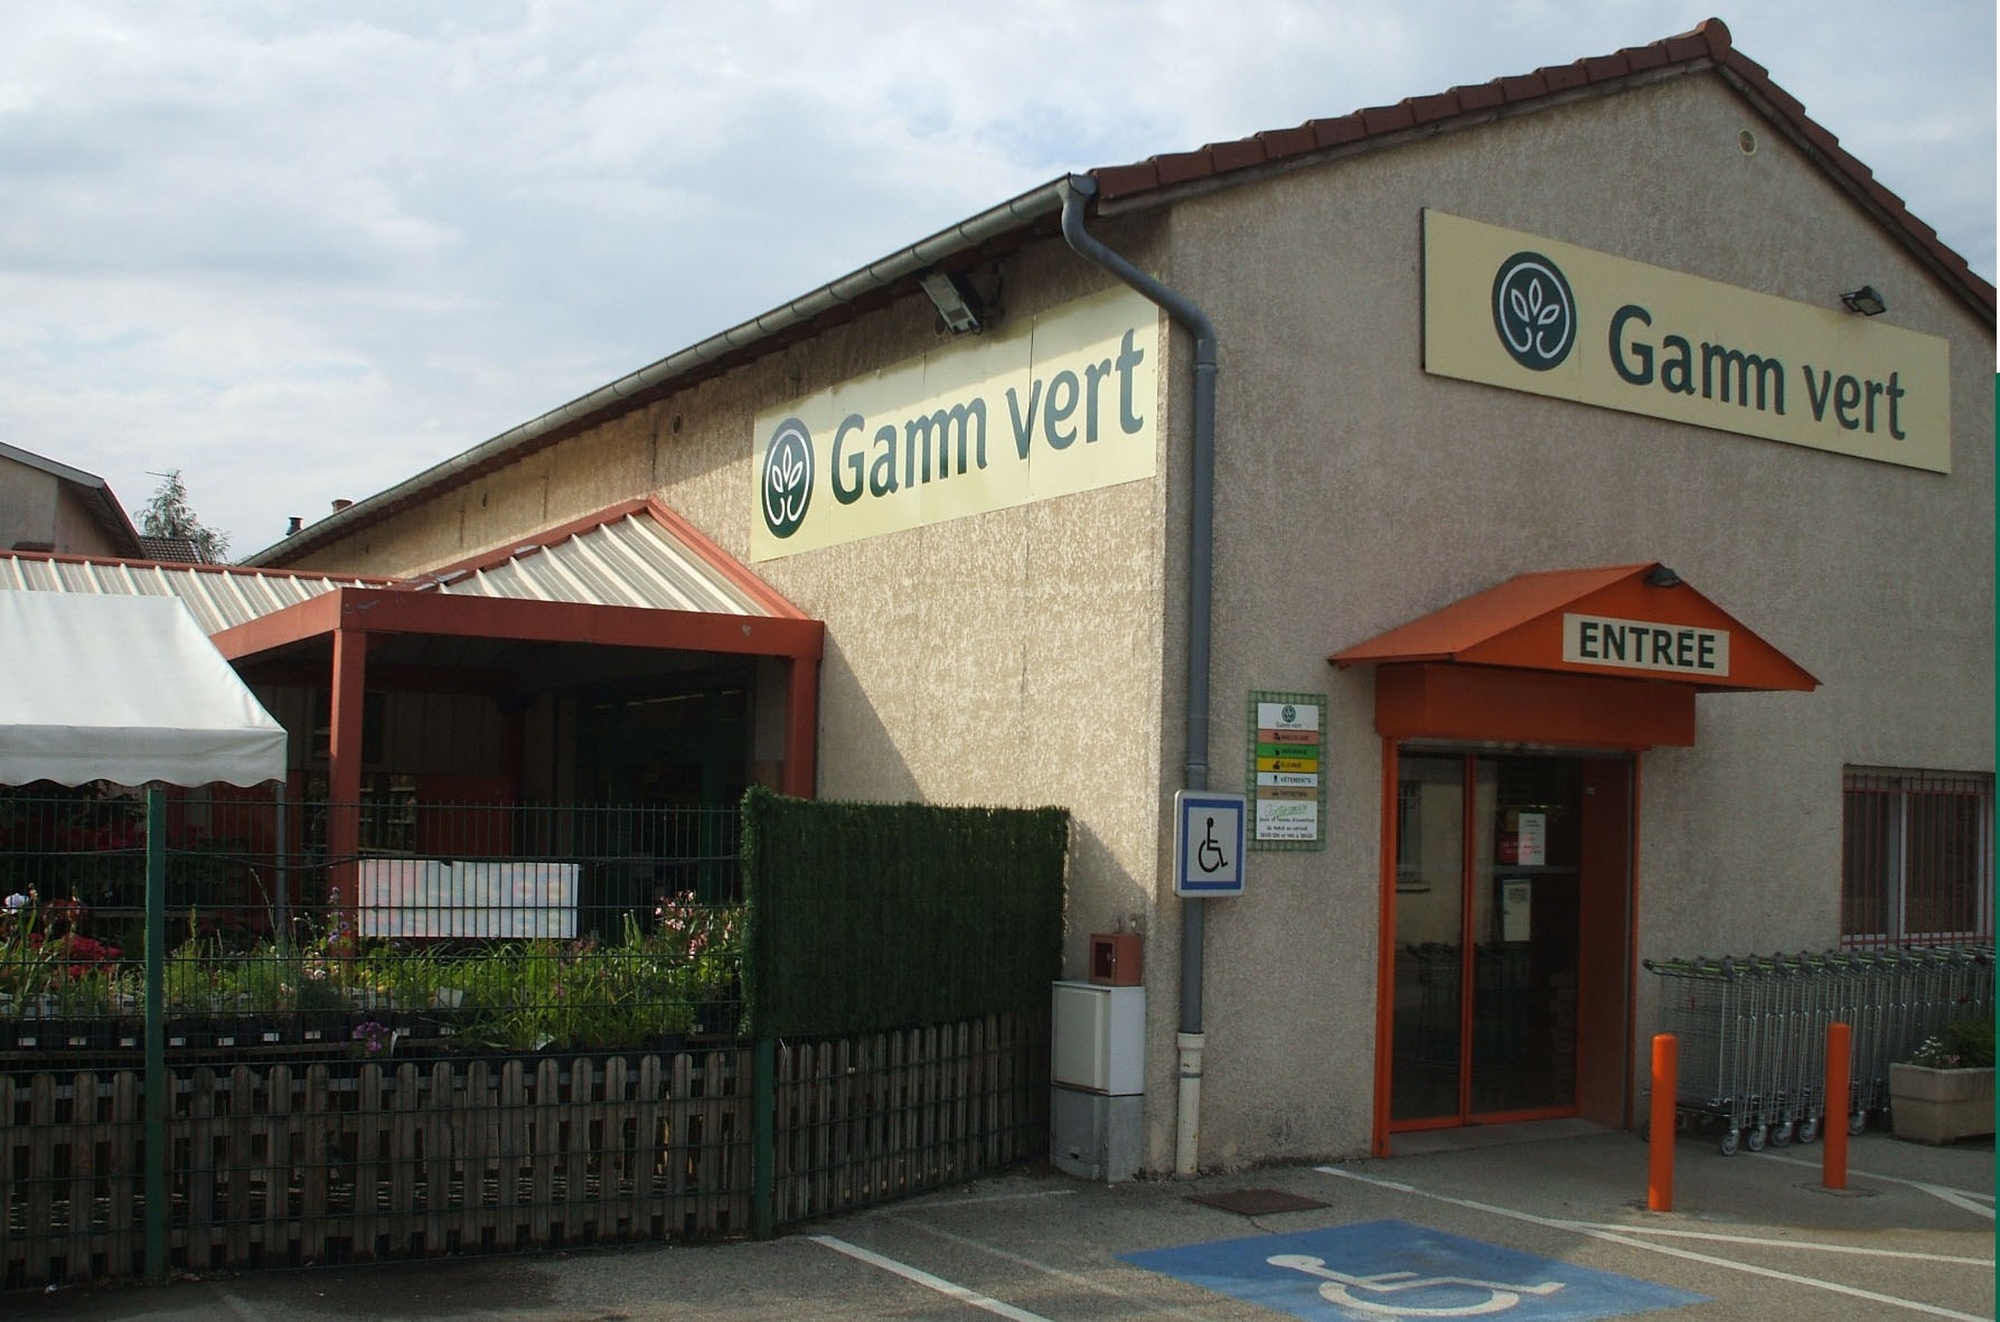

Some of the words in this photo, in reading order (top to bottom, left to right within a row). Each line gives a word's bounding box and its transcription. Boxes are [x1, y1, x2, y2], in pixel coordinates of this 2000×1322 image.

[830, 397, 988, 505] Gamm
[1005, 328, 1144, 460] vert
[1608, 304, 1786, 416] Gamm
[1802, 365, 1906, 441] vert
[1580, 621, 1715, 669] ENTRÉE
